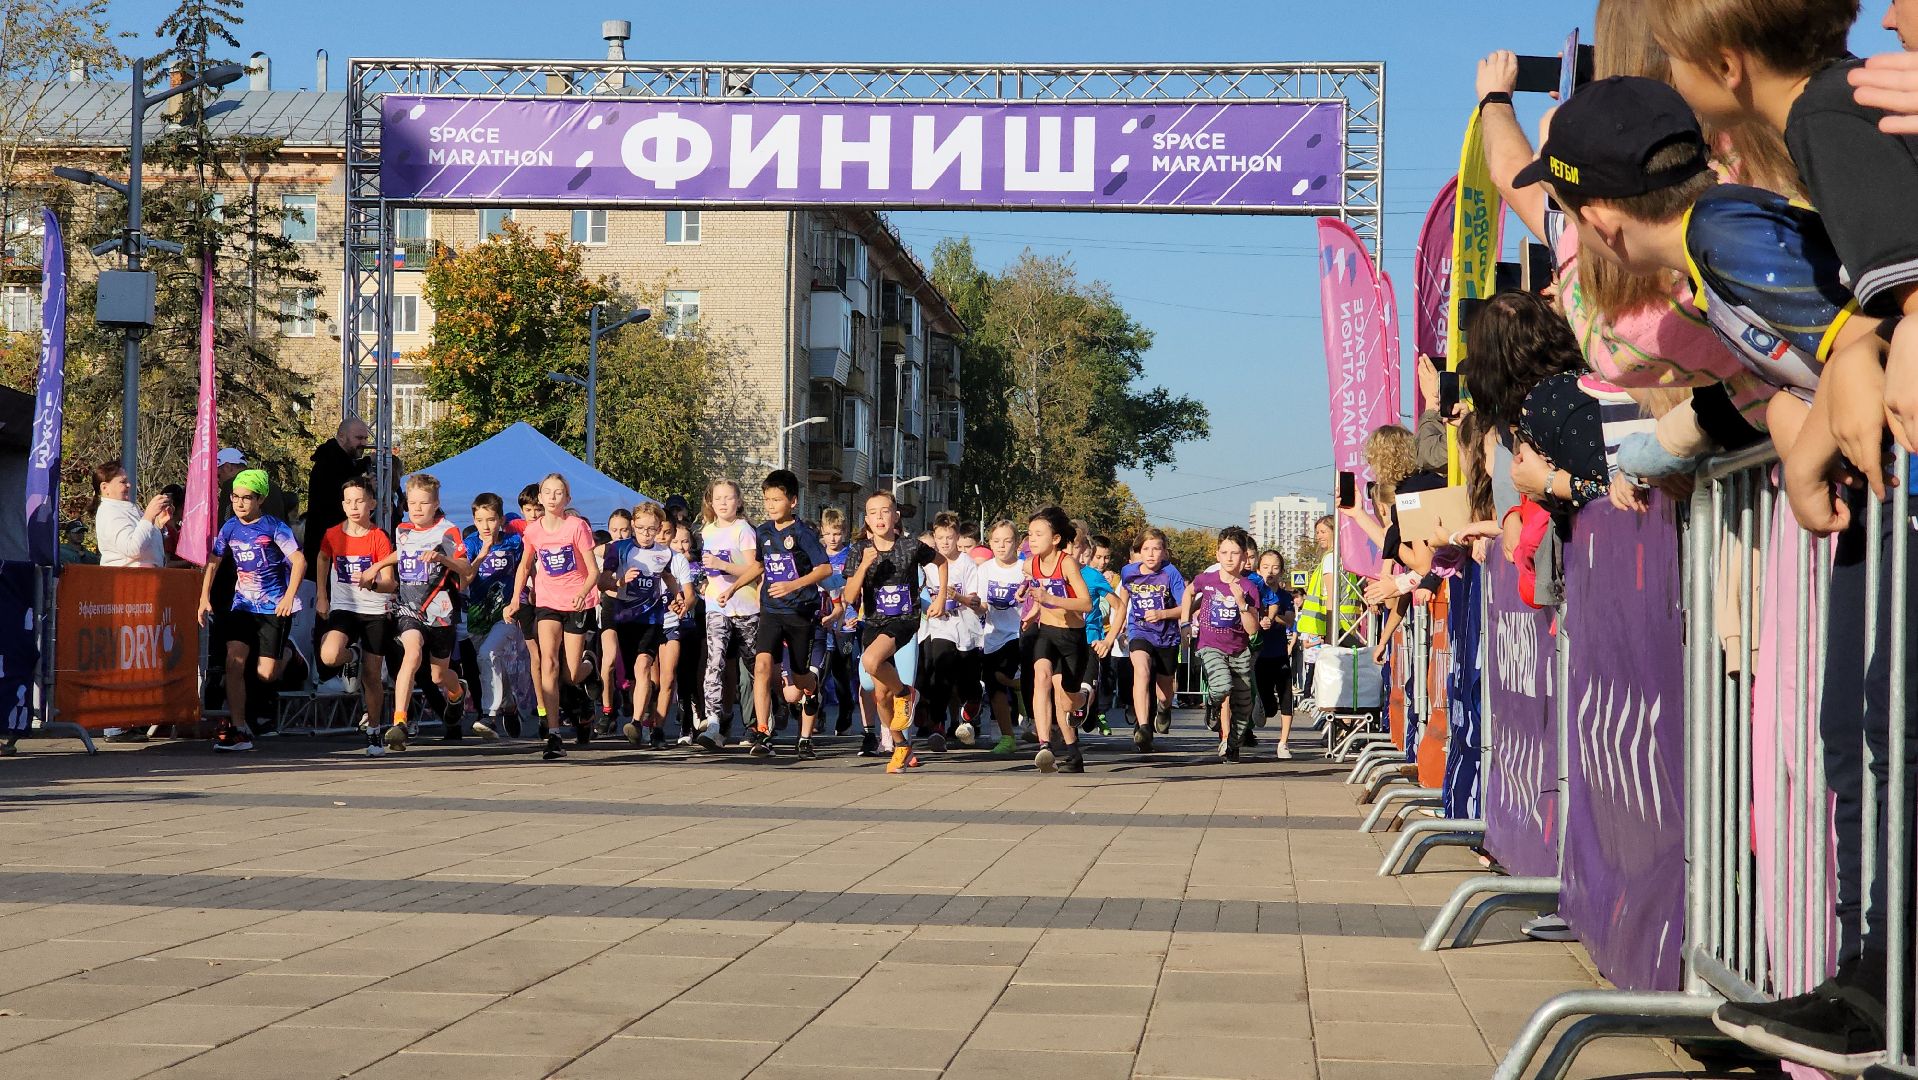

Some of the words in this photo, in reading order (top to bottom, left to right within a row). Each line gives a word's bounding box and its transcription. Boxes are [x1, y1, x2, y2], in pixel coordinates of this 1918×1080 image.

[429, 127, 500, 144] SPACE
[1152, 133, 1226, 150] SPACE
[428, 149, 553, 167] MARATHON
[621, 112, 1096, 193] ФИНИШ
[1152, 155, 1282, 172] MARATHON
[1550, 155, 1580, 185] РЕГБИ
[1436, 257, 1452, 355] SPACE
[237, 551, 255, 562] 159
[545, 553, 566, 565] 155
[344, 563, 361, 573] 115
[402, 558, 416, 570] 151
[490, 558, 508, 569] 139
[769, 562, 785, 572] 134
[637, 578, 653, 588] 116
[880, 593, 901, 604] 149
[994, 588, 1008, 598] 117
[1136, 599, 1155, 609] 132
[1218, 608, 1237, 618] 135
